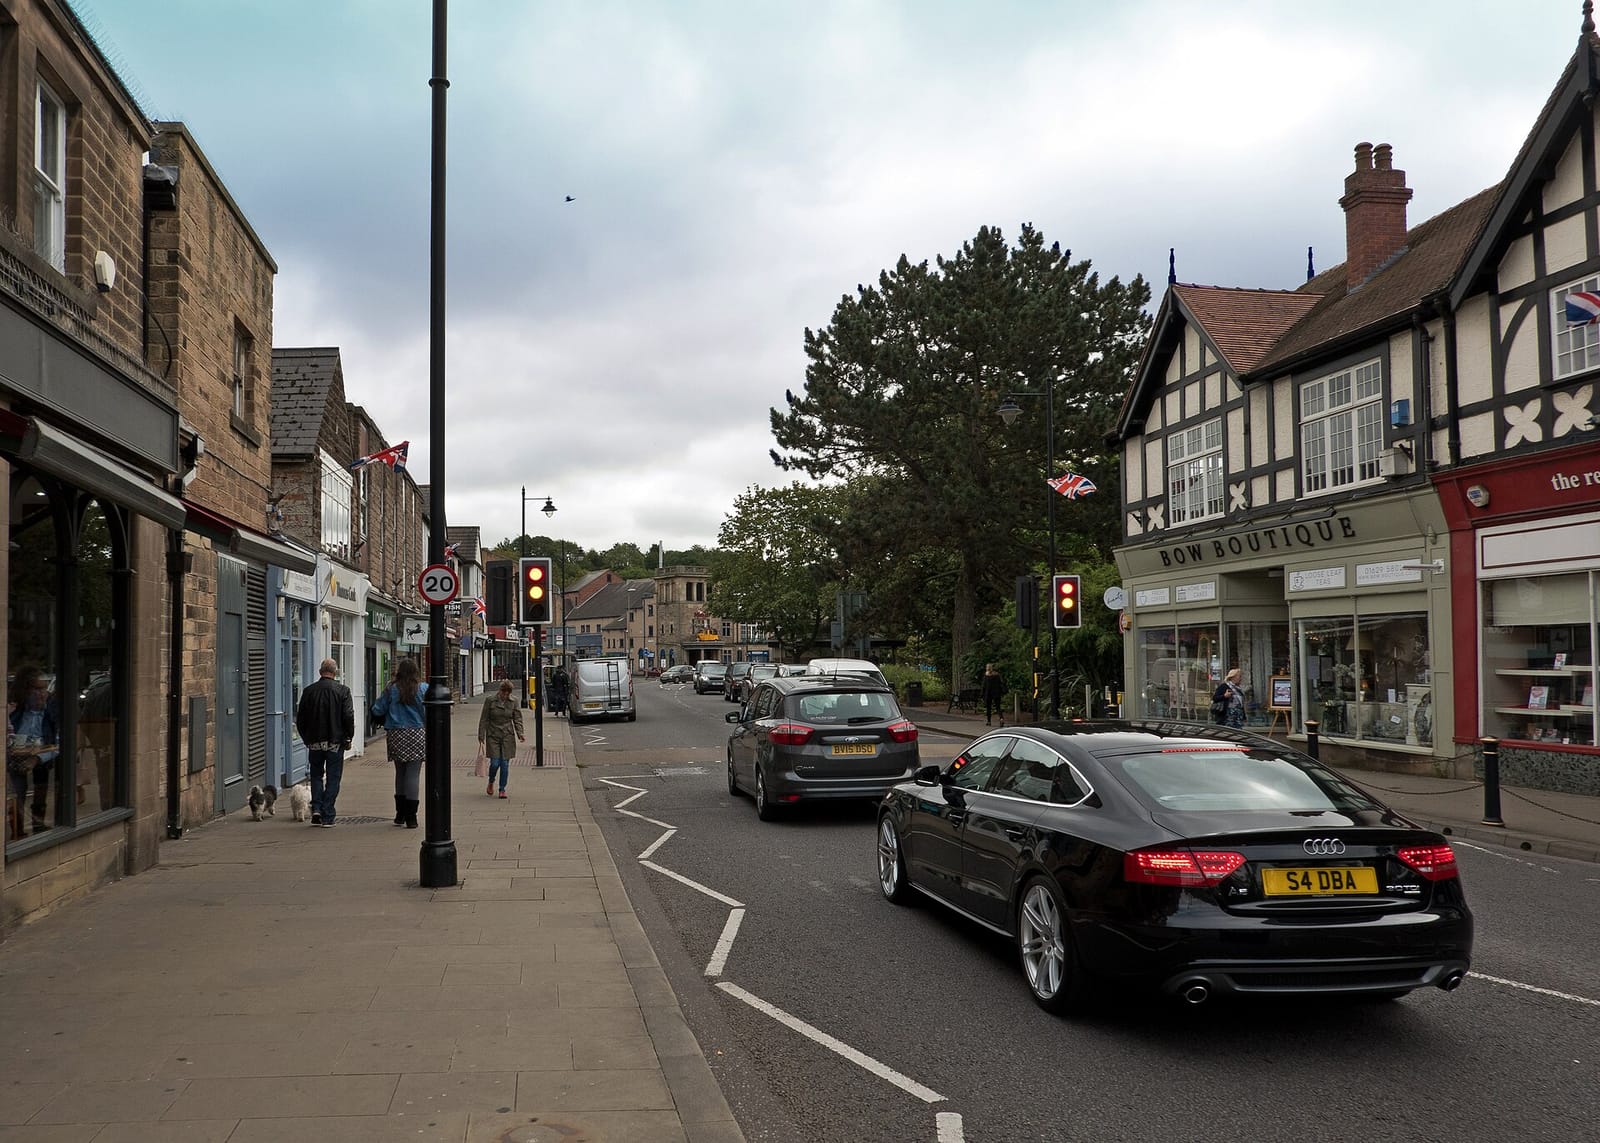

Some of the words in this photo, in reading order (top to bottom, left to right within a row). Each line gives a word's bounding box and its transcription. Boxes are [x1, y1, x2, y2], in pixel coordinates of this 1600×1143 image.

[1551, 472, 1580, 491] the
[1160, 543, 1203, 567] BOW
[1213, 516, 1356, 558] BOUTIQUE
[1304, 570, 1325, 579] LOOSE
[1327, 568, 1343, 577] LEAF
[1316, 578, 1331, 586] TEAS
[425, 576, 453, 592] 20
[1286, 871, 1312, 891] S4
[1318, 871, 1357, 890] DBA
